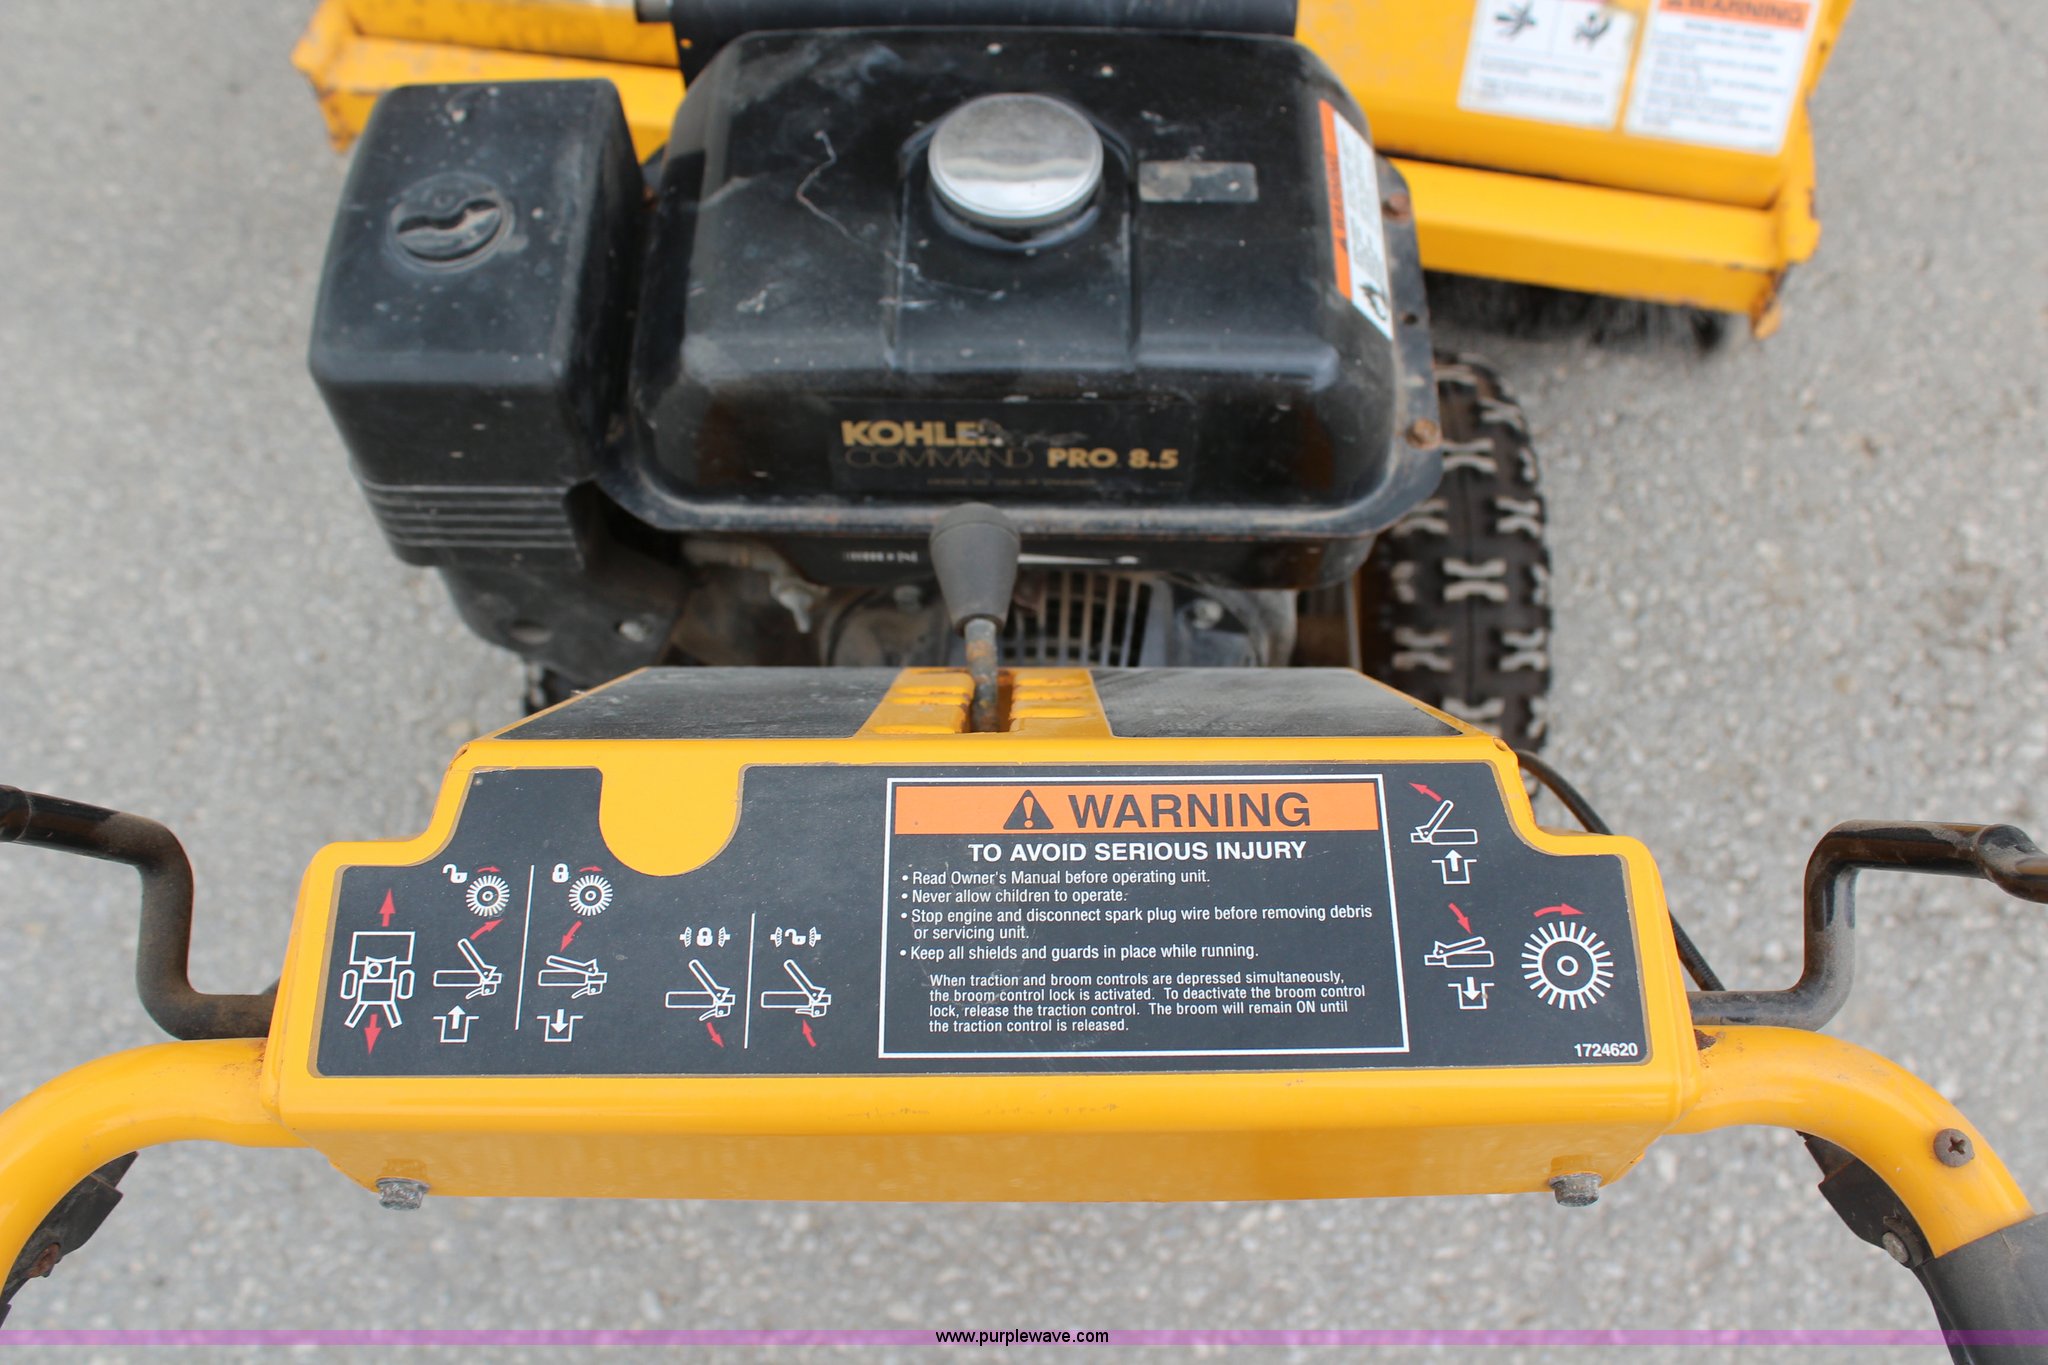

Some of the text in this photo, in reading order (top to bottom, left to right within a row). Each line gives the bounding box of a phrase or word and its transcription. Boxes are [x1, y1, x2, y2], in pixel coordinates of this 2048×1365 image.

[845, 447, 1179, 470] COMMAND PRO 8.5
[1067, 792, 1312, 829] WARNING
[968, 840, 1306, 862] TO AVOID SERIOUS INJURY
[912, 868, 1209, 886] Read Owner's Manual before operating unit.
[912, 888, 1128, 904] Never allow children to operate.
[911, 903, 1372, 926] Stop engine and disconnect spark plug wire before removing debris
[914, 924, 1029, 942] or servicing unit.
[910, 943, 1258, 963] Keep all shields and guards in place while running.
[929, 969, 1343, 987] When traction and broom controls are depressed simultaneously,
[929, 984, 1364, 1002] the broom control lock is activated. To deactivate the broom control
[929, 999, 1347, 1019] lock, release the traction control. The broom will remain ON until
[928, 1017, 1128, 1033] the traction control is released.
[1574, 1042, 1638, 1057] 1724620
